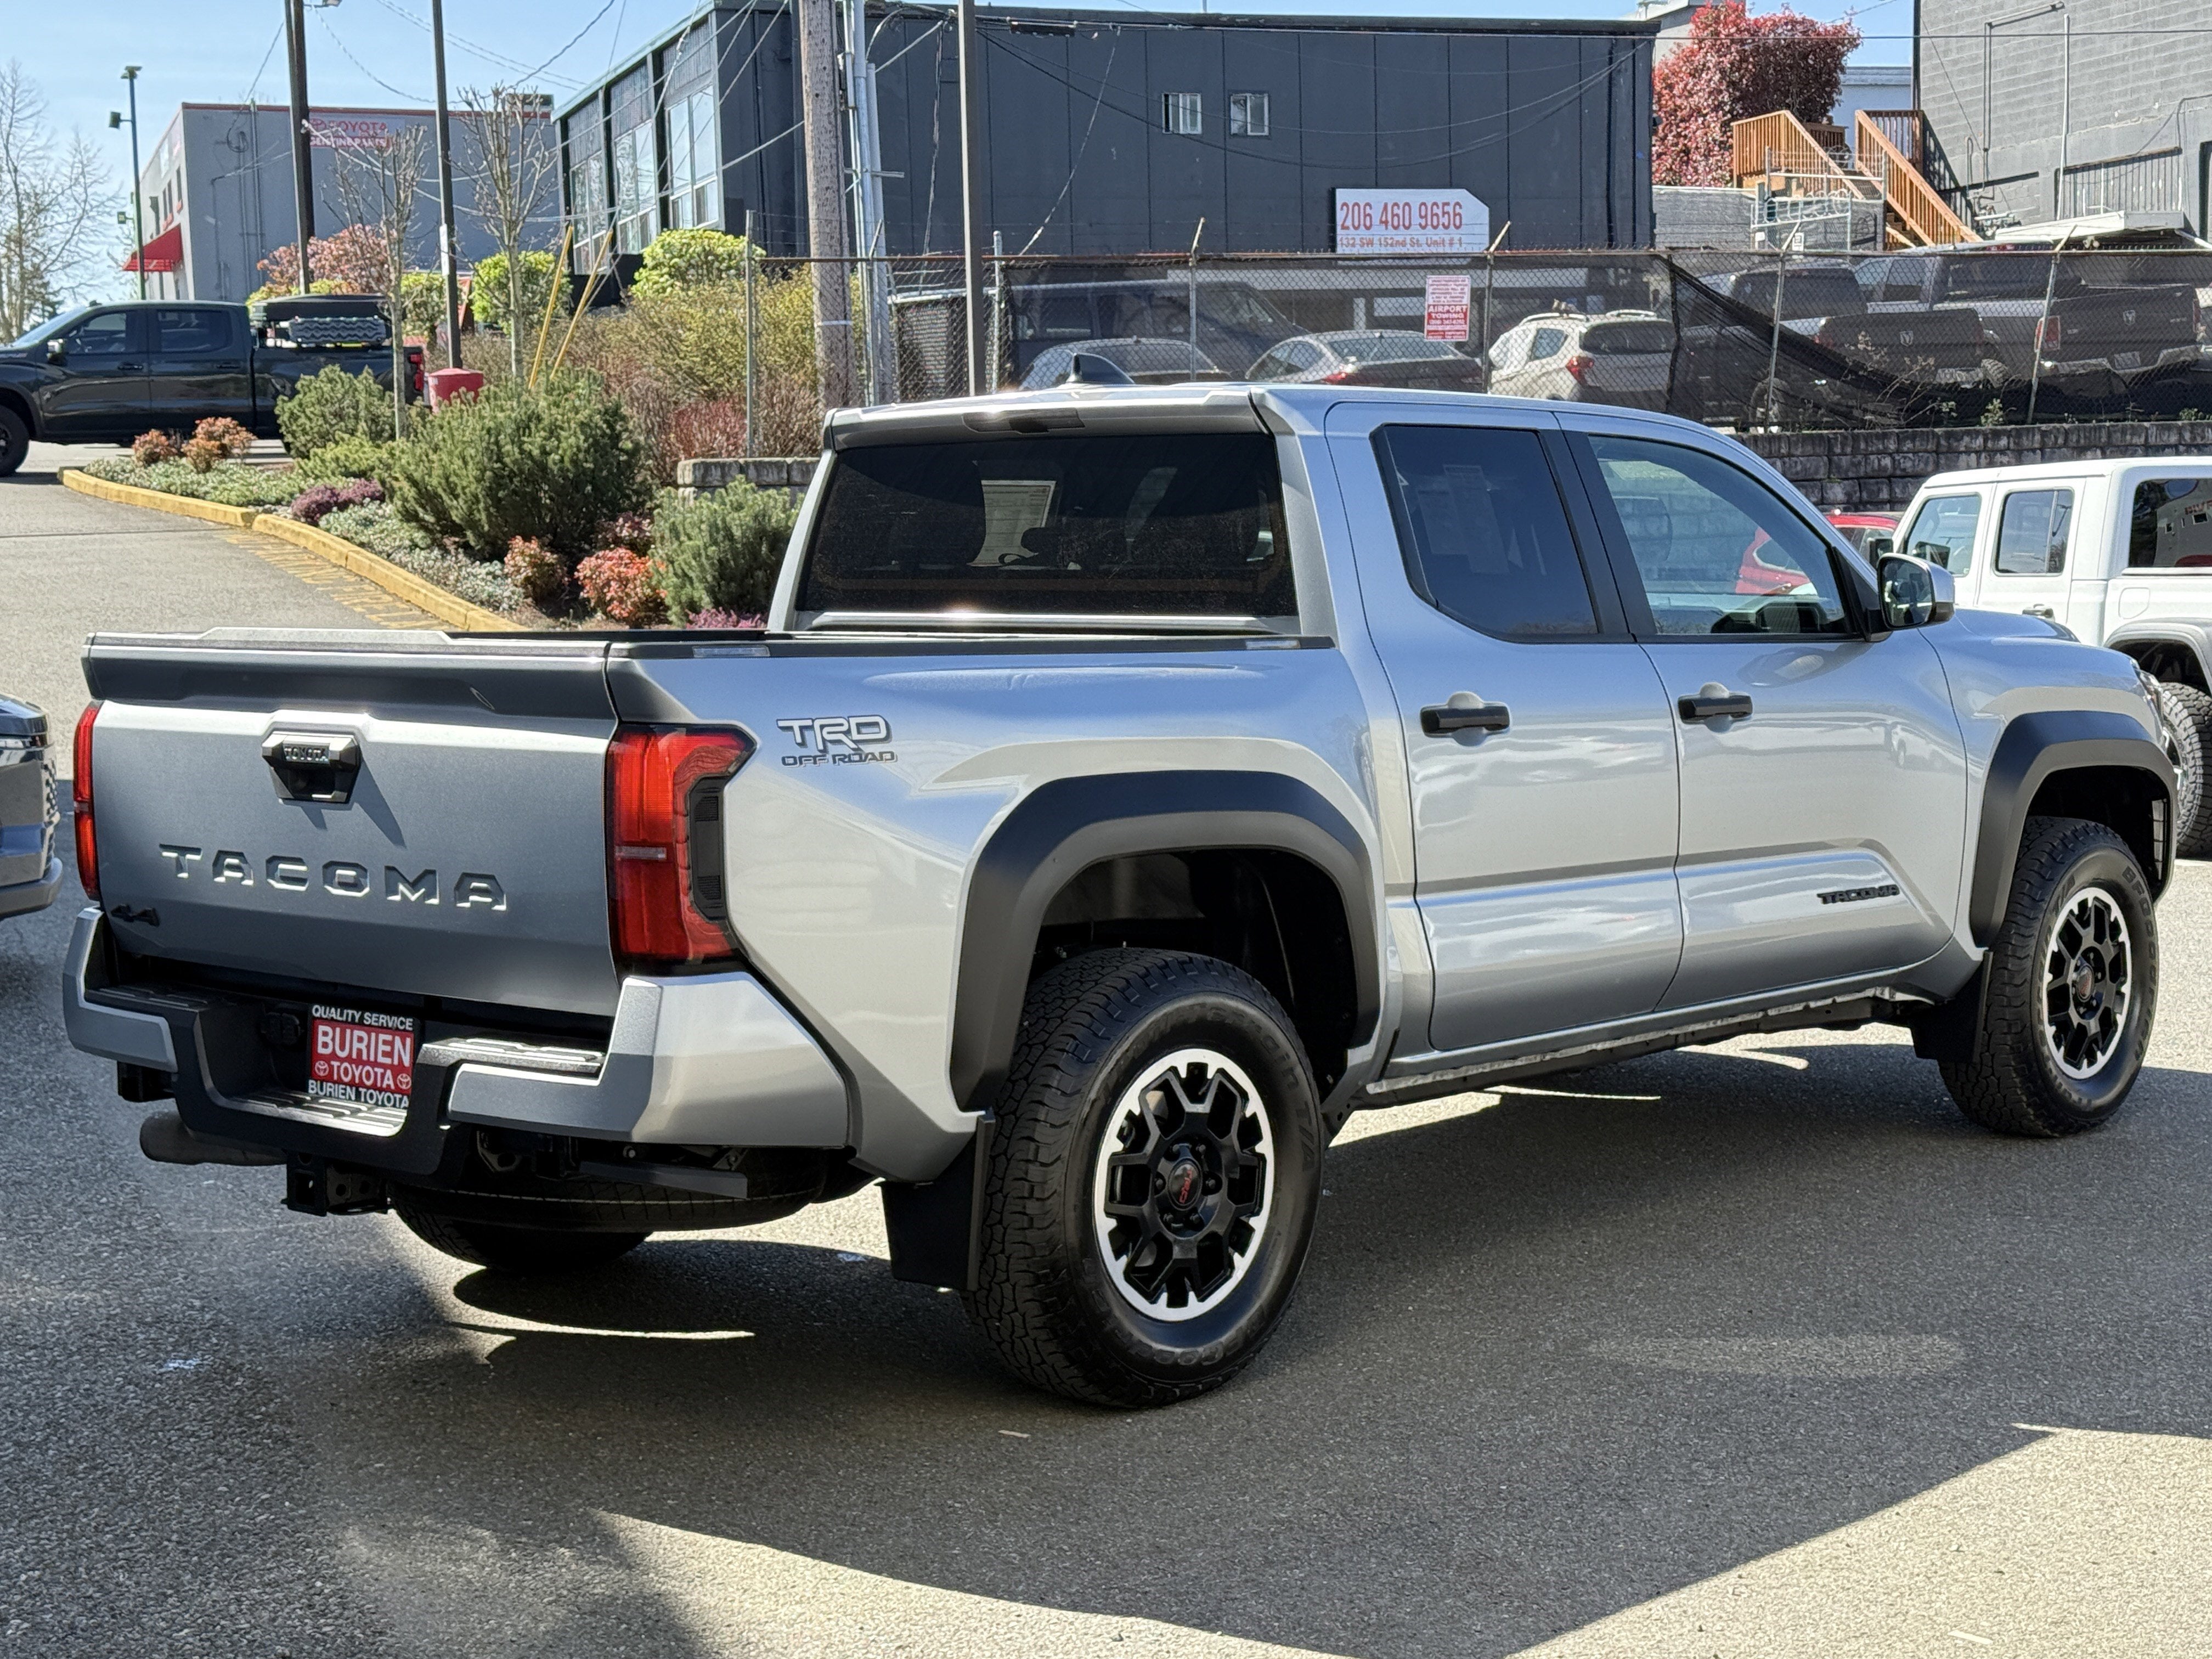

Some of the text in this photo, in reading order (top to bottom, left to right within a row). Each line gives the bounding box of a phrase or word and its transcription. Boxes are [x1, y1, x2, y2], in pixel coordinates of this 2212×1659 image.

[1340, 201, 1463, 230] 206 460 9656
[1339, 236, 1356, 247] 132
[1359, 236, 1374, 247] SW
[1378, 236, 1407, 247] 152nd
[1409, 236, 1423, 247] St.
[1425, 236, 1446, 247] Unit
[776, 714, 892, 753] TRD
[284, 746, 329, 763] TOYOTA
[781, 751, 896, 766] OFF ROAD
[159, 843, 507, 911] TACOMA
[312, 1005, 414, 1030] QUALITY SERVICE
[317, 1025, 411, 1067] BURIEN
[330, 1060, 395, 1090] TOYOTA
[308, 1080, 409, 1109] BURIEN TOYOTA
